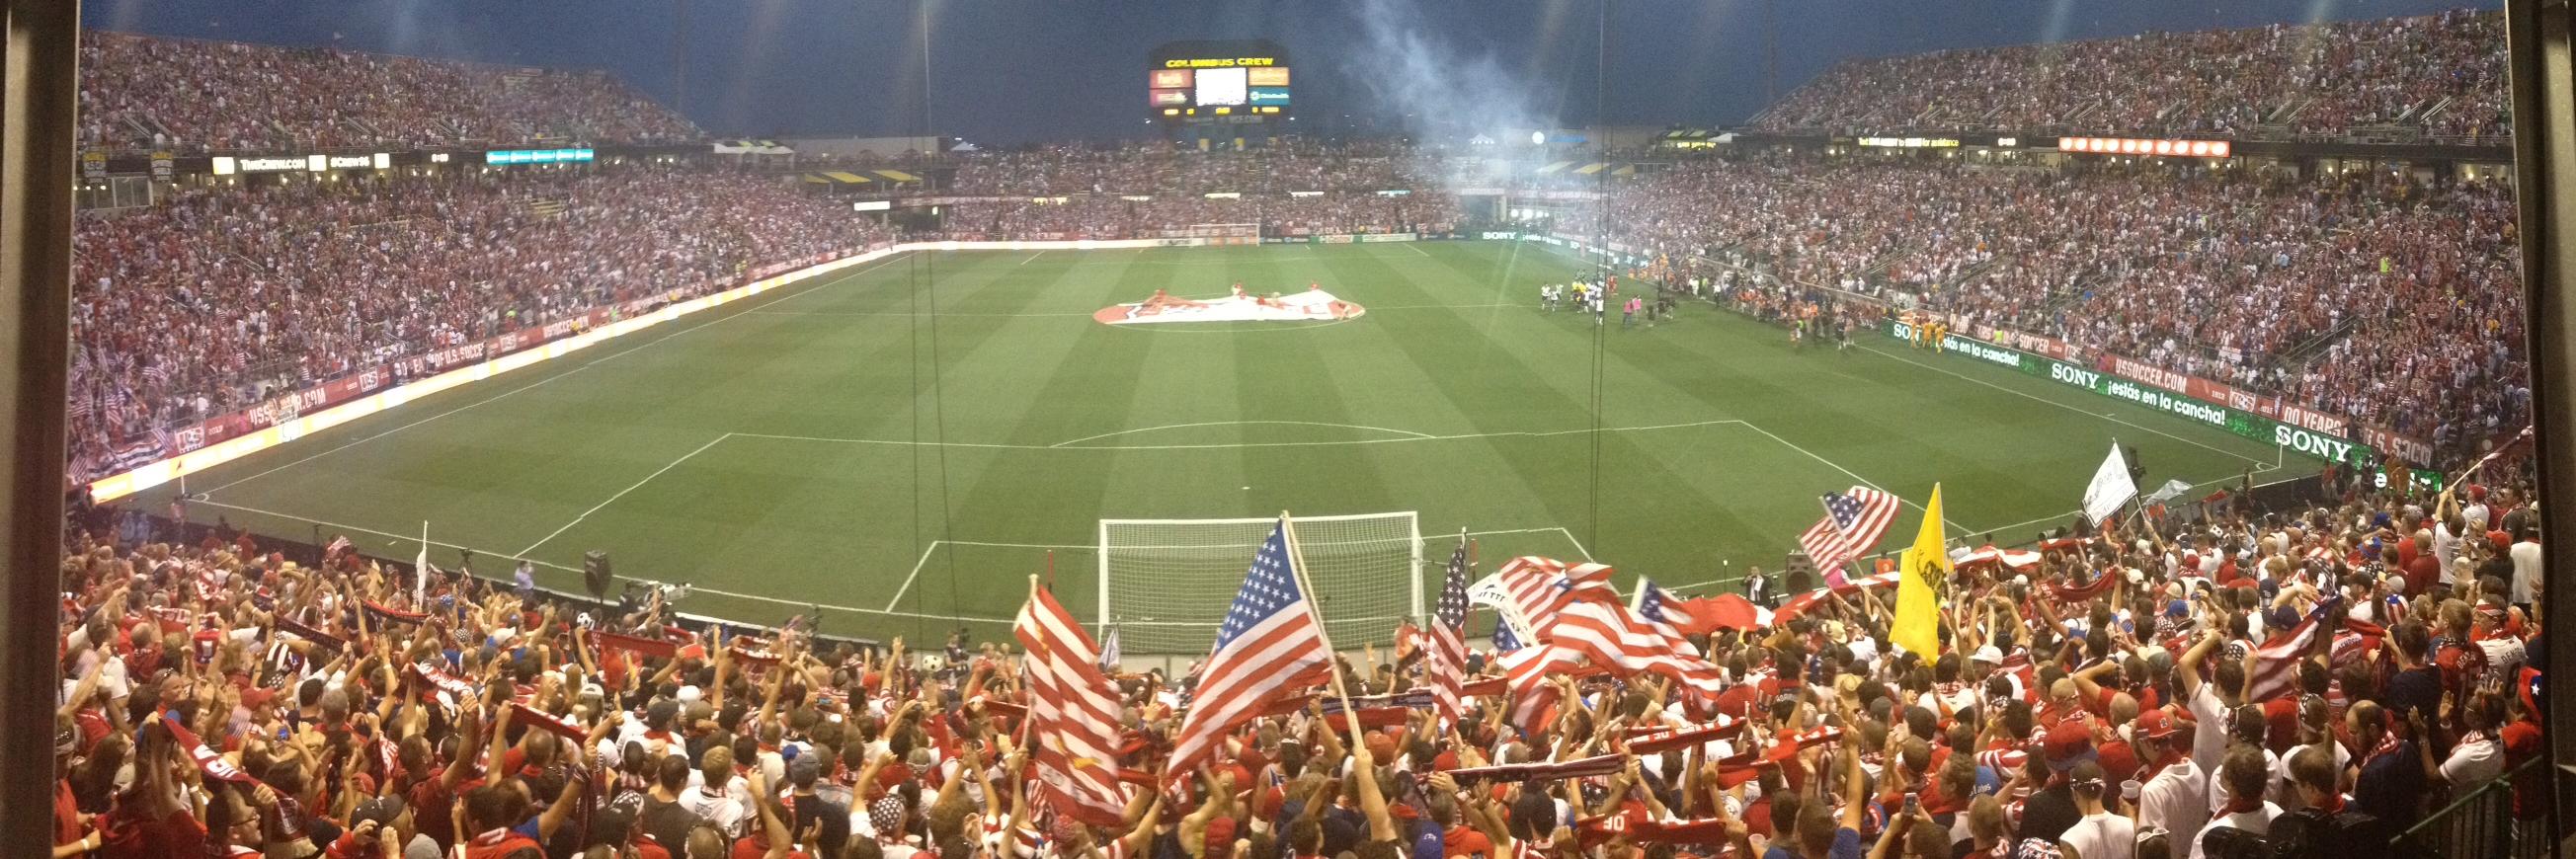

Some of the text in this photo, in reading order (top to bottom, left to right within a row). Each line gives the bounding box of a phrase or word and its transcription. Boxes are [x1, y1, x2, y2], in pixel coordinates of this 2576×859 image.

[1237, 57, 1274, 66] CREW
[2052, 362, 2099, 389] SONY
[2116, 357, 2188, 393] USSOCCER.COM
[2108, 380, 2225, 426] ¡estás en la cancha!
[2275, 425, 2352, 462] SONY
